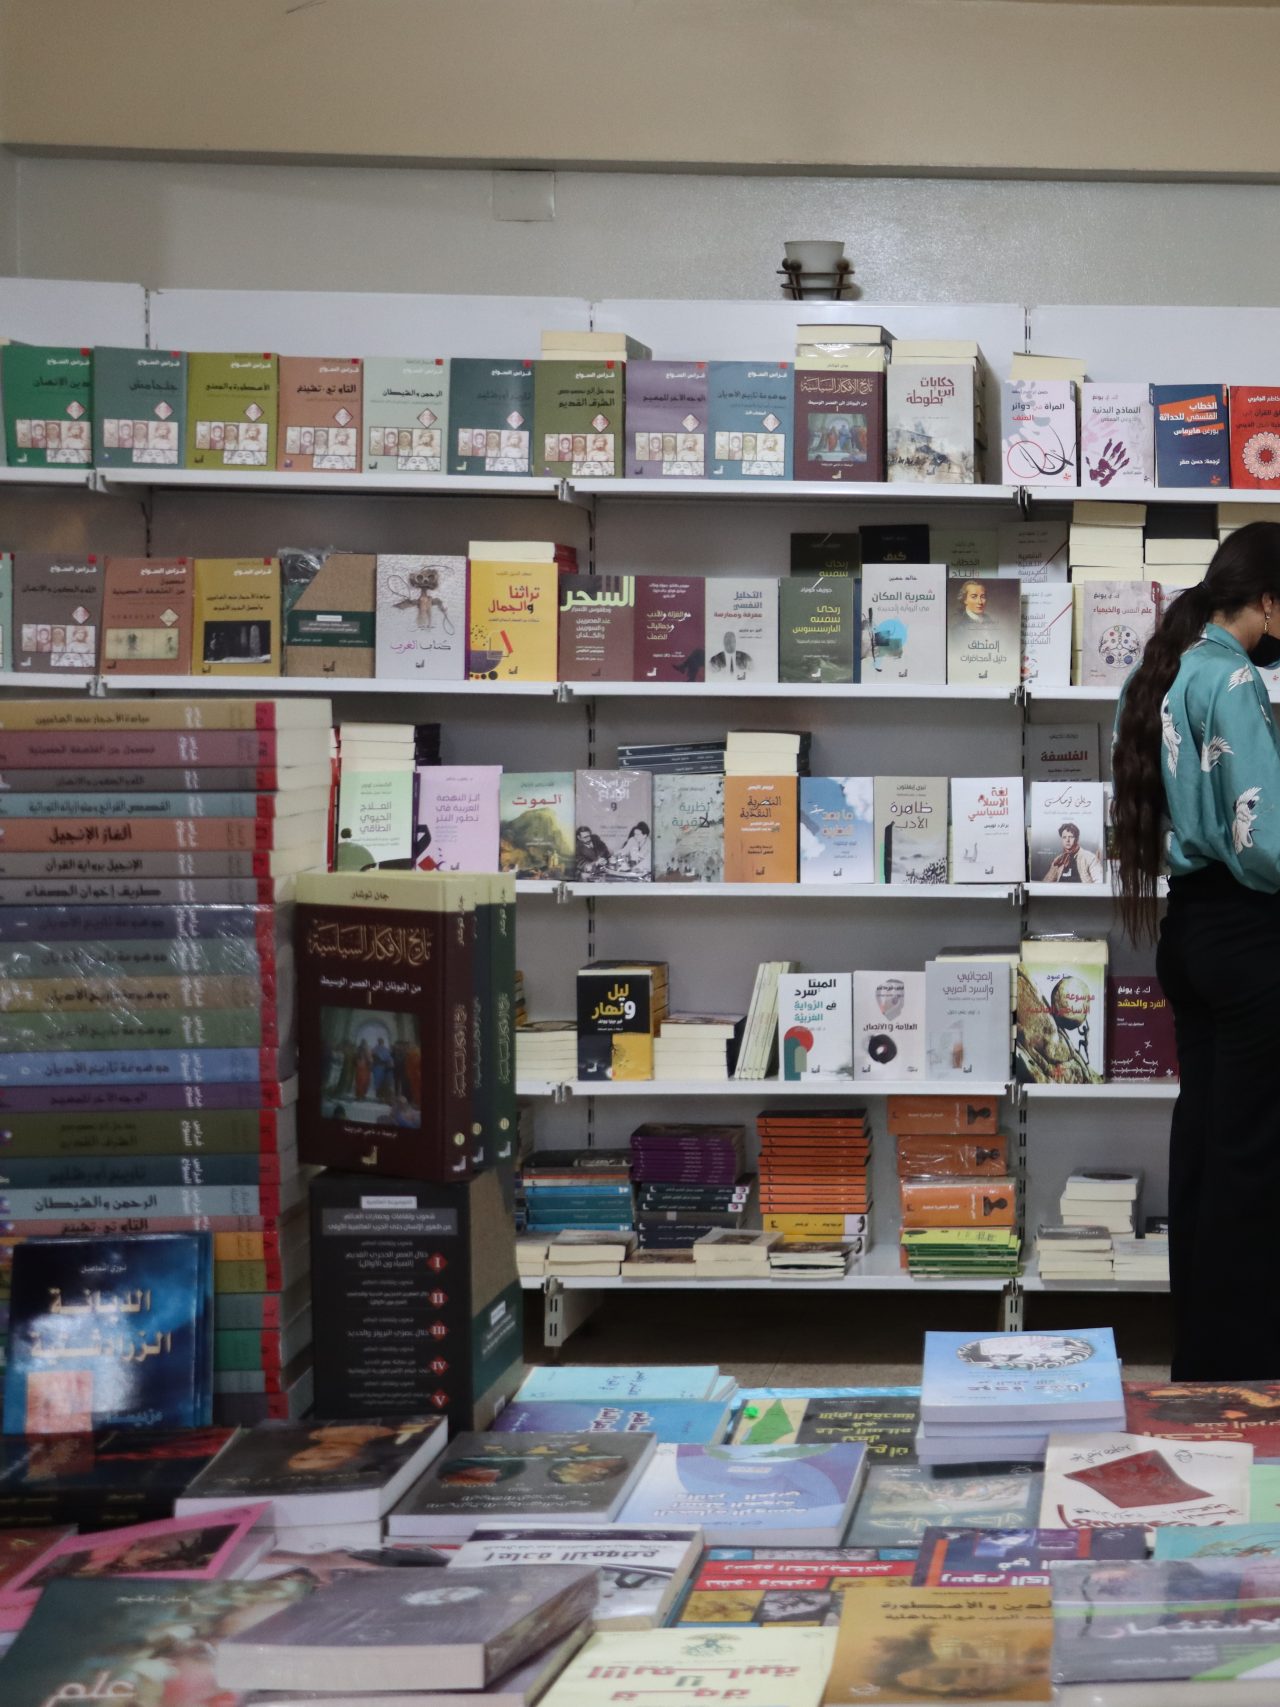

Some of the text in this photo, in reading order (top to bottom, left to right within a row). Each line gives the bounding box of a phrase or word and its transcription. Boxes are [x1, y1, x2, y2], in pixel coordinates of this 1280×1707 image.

[560, 576, 635, 611] السحر
[607, 984, 630, 1000] ليل
[592, 1000, 636, 1020] ونهار
